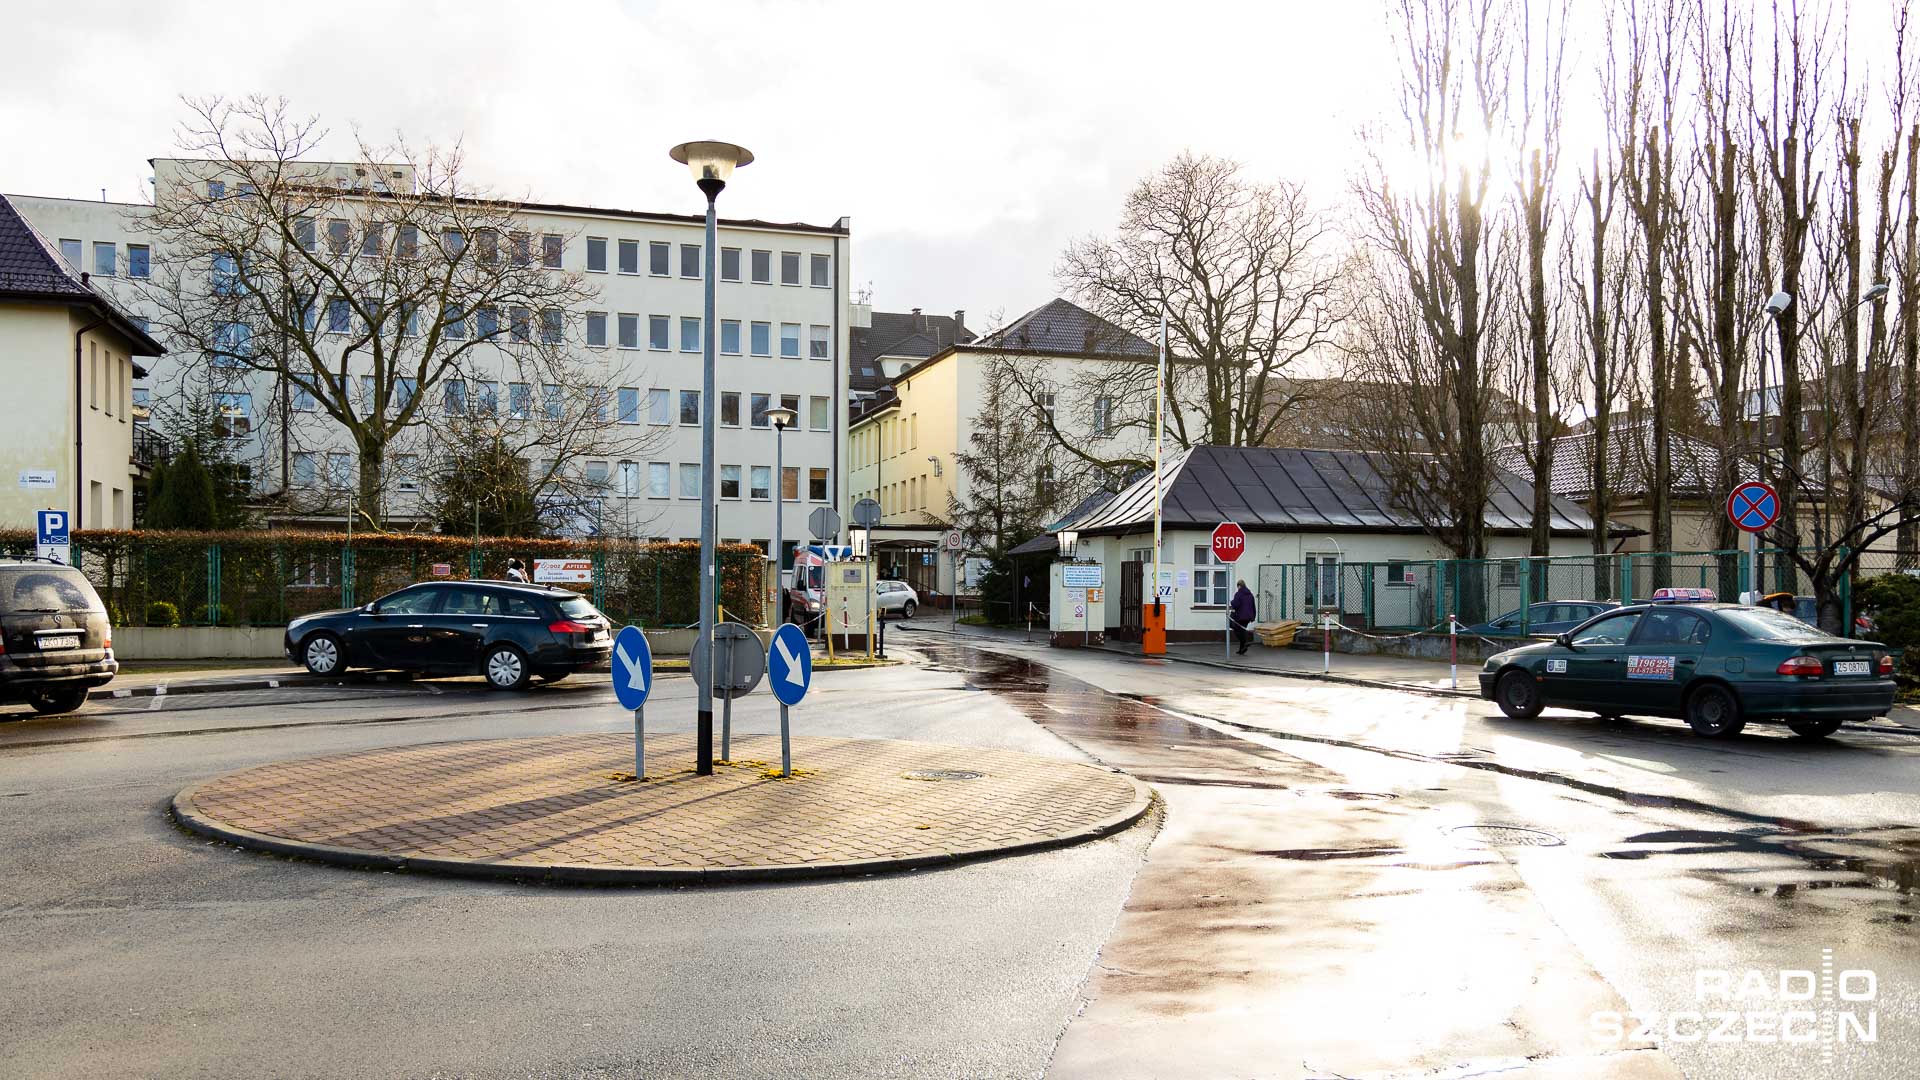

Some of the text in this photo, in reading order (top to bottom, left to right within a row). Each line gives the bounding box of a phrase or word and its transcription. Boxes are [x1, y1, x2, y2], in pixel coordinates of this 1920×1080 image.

[45, 513, 64, 535] P
[1215, 536, 1243, 549] STOP
[1837, 662, 1847, 672] ZS
